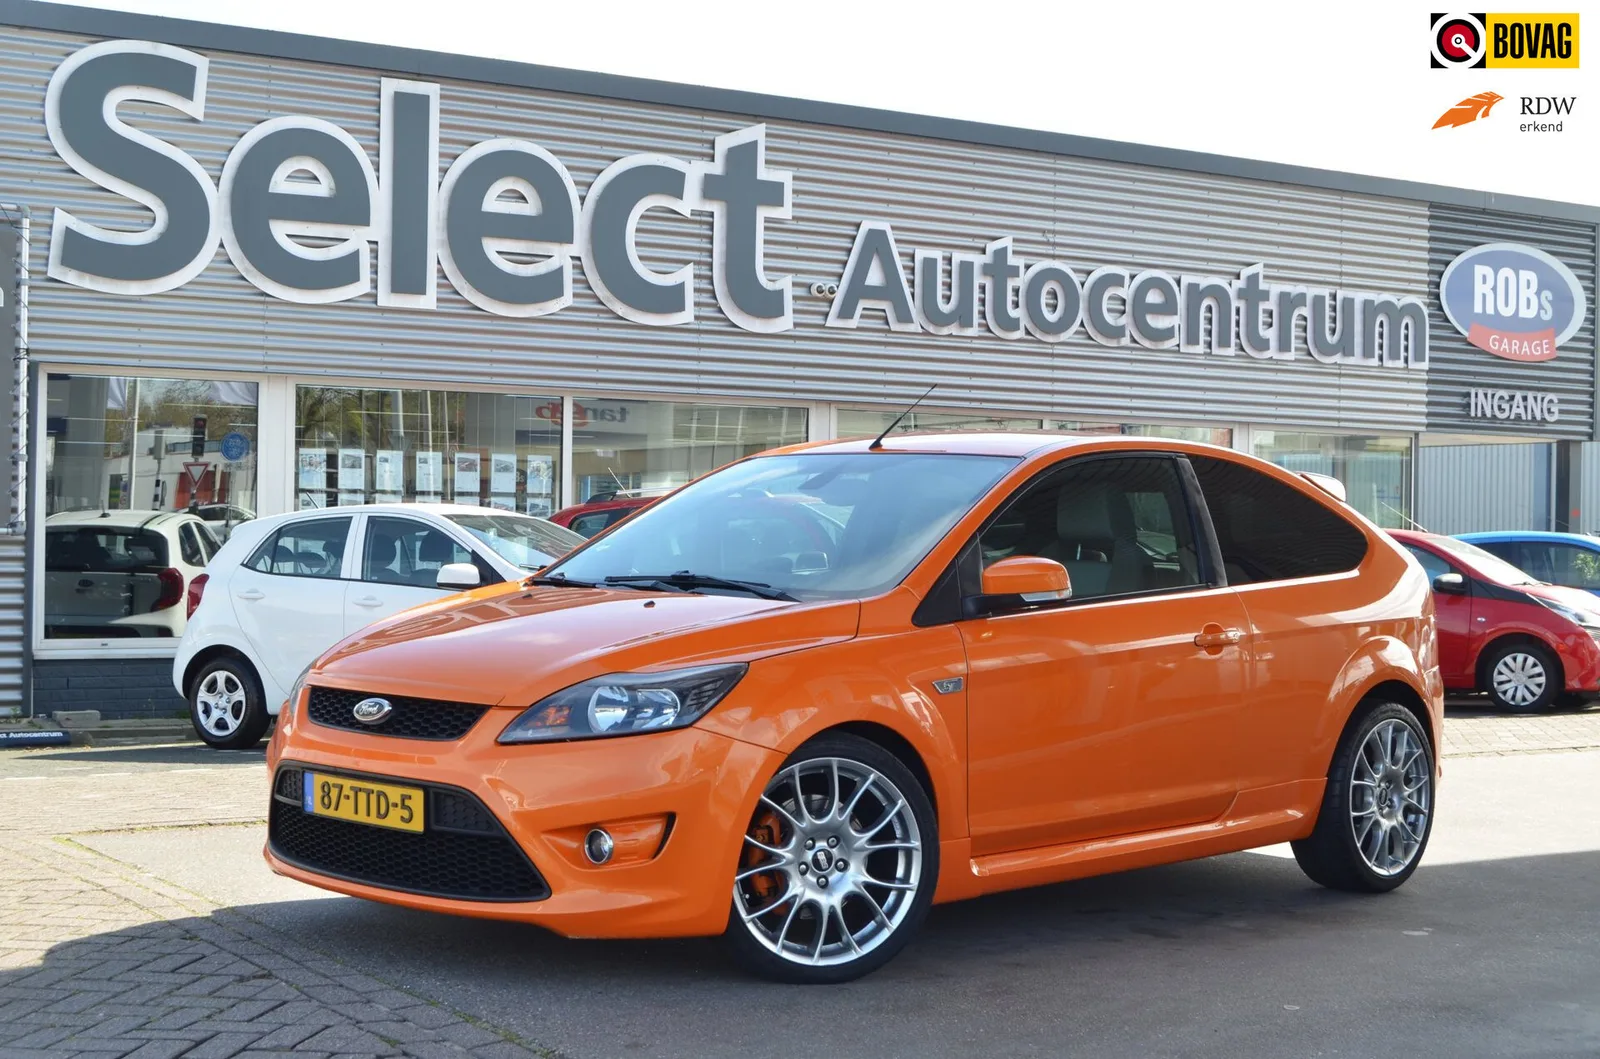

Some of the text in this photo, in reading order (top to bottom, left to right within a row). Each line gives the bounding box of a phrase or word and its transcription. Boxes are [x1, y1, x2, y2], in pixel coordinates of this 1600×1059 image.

[46, 40, 1429, 370] Select Autocentrum
[1489, 335, 1551, 356] GARAGE
[1470, 388, 1559, 422] INGANG
[358, 702, 380, 715] Ford
[9, 731, 64, 739] Autocentrum
[320, 780, 414, 824] 87-TTD-5
